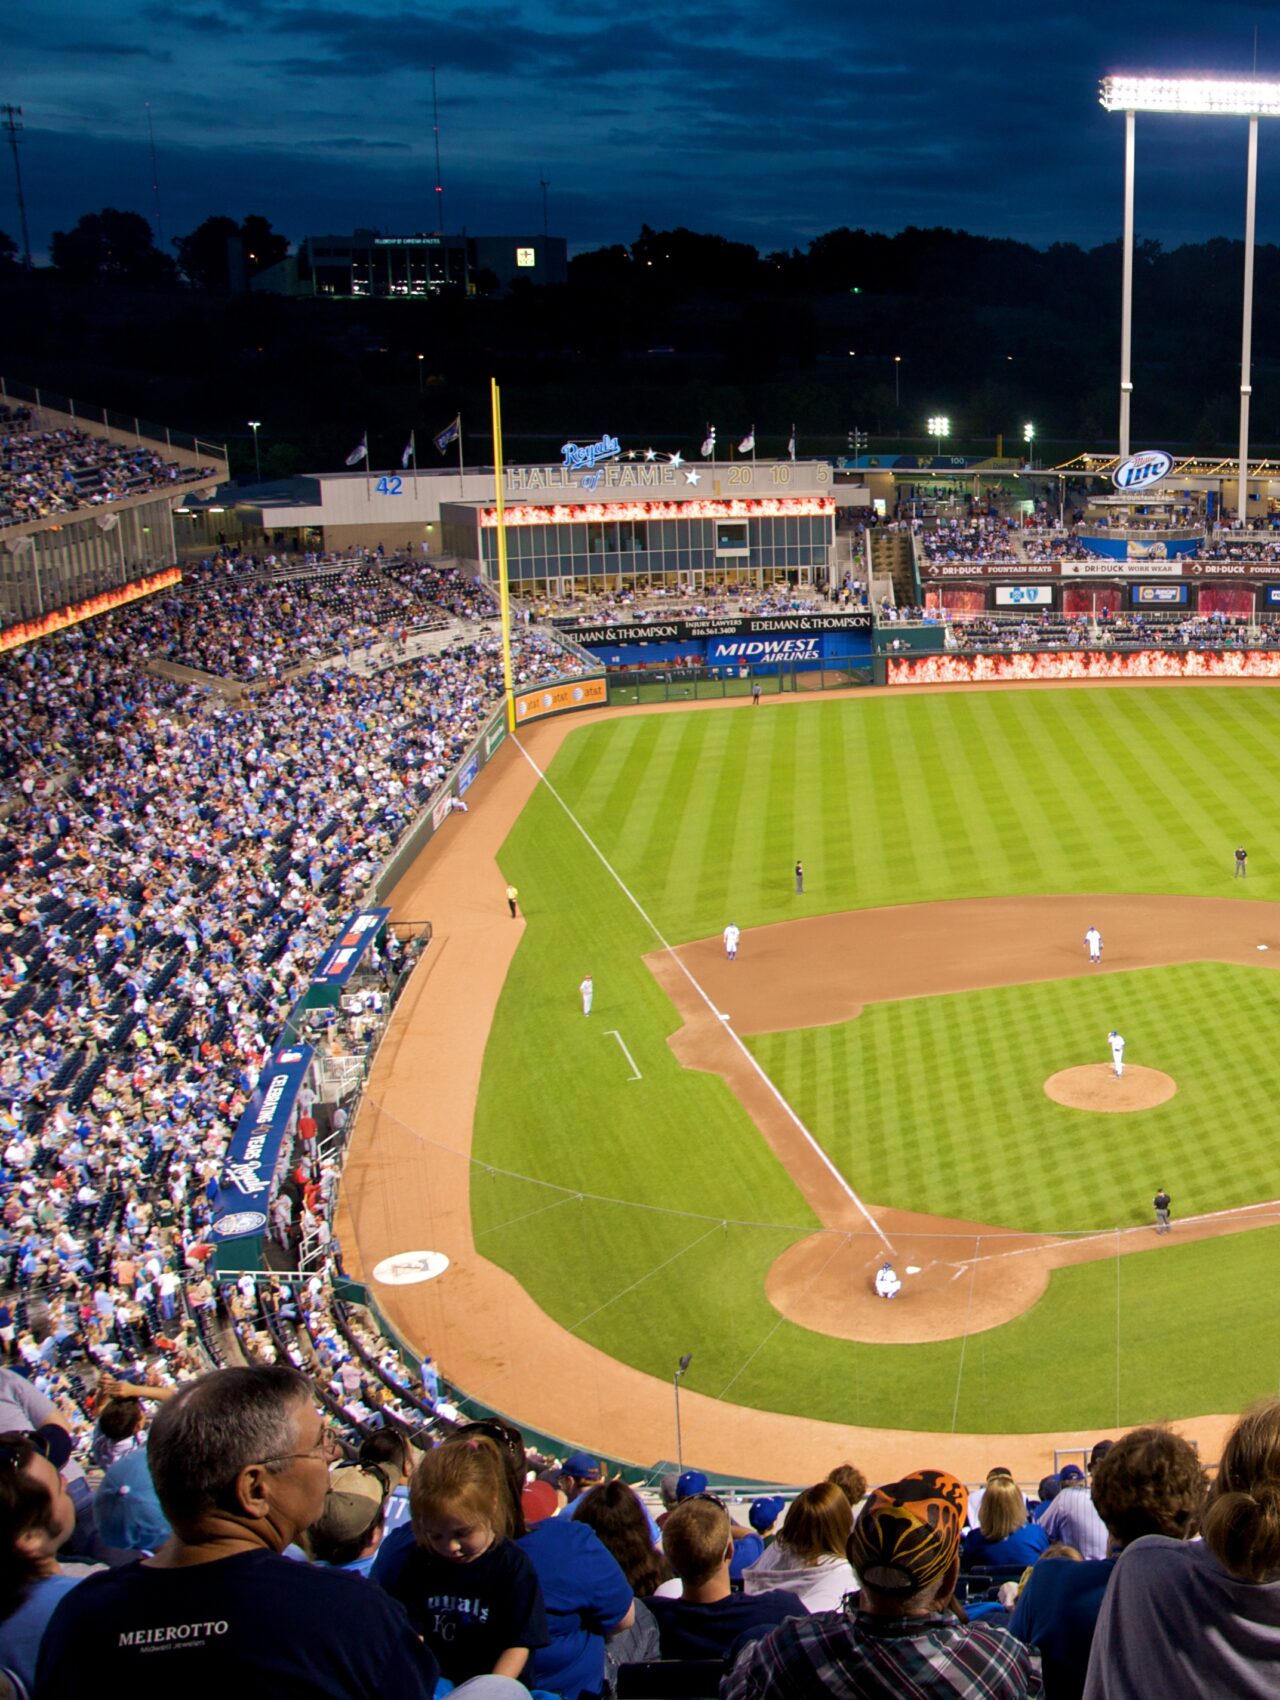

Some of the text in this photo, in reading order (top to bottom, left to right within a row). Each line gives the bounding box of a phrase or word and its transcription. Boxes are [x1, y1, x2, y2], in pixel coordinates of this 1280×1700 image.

[561, 434, 621, 469] Royals
[507, 464, 677, 492] HALL of FAME
[727, 464, 830, 486] 20 10 5
[1124, 461, 1165, 487] Lite
[375, 475, 403, 496] 42
[987, 566, 1027, 574] FOUNTAIN
[1028, 565, 1053, 573] SEATS
[605, 627, 617, 641] &
[617, 625, 678, 639] THOMPSON
[685, 618, 743, 629] INJURY LAWYERS
[750, 616, 871, 632] EDELMAN & THOMPSON
[715, 638, 820, 657] MIDWEST
[760, 650, 820, 663] AIRLINES
[243, 1133, 267, 1161] YEARS
[118, 1620, 230, 1647] MEIEROTTO
